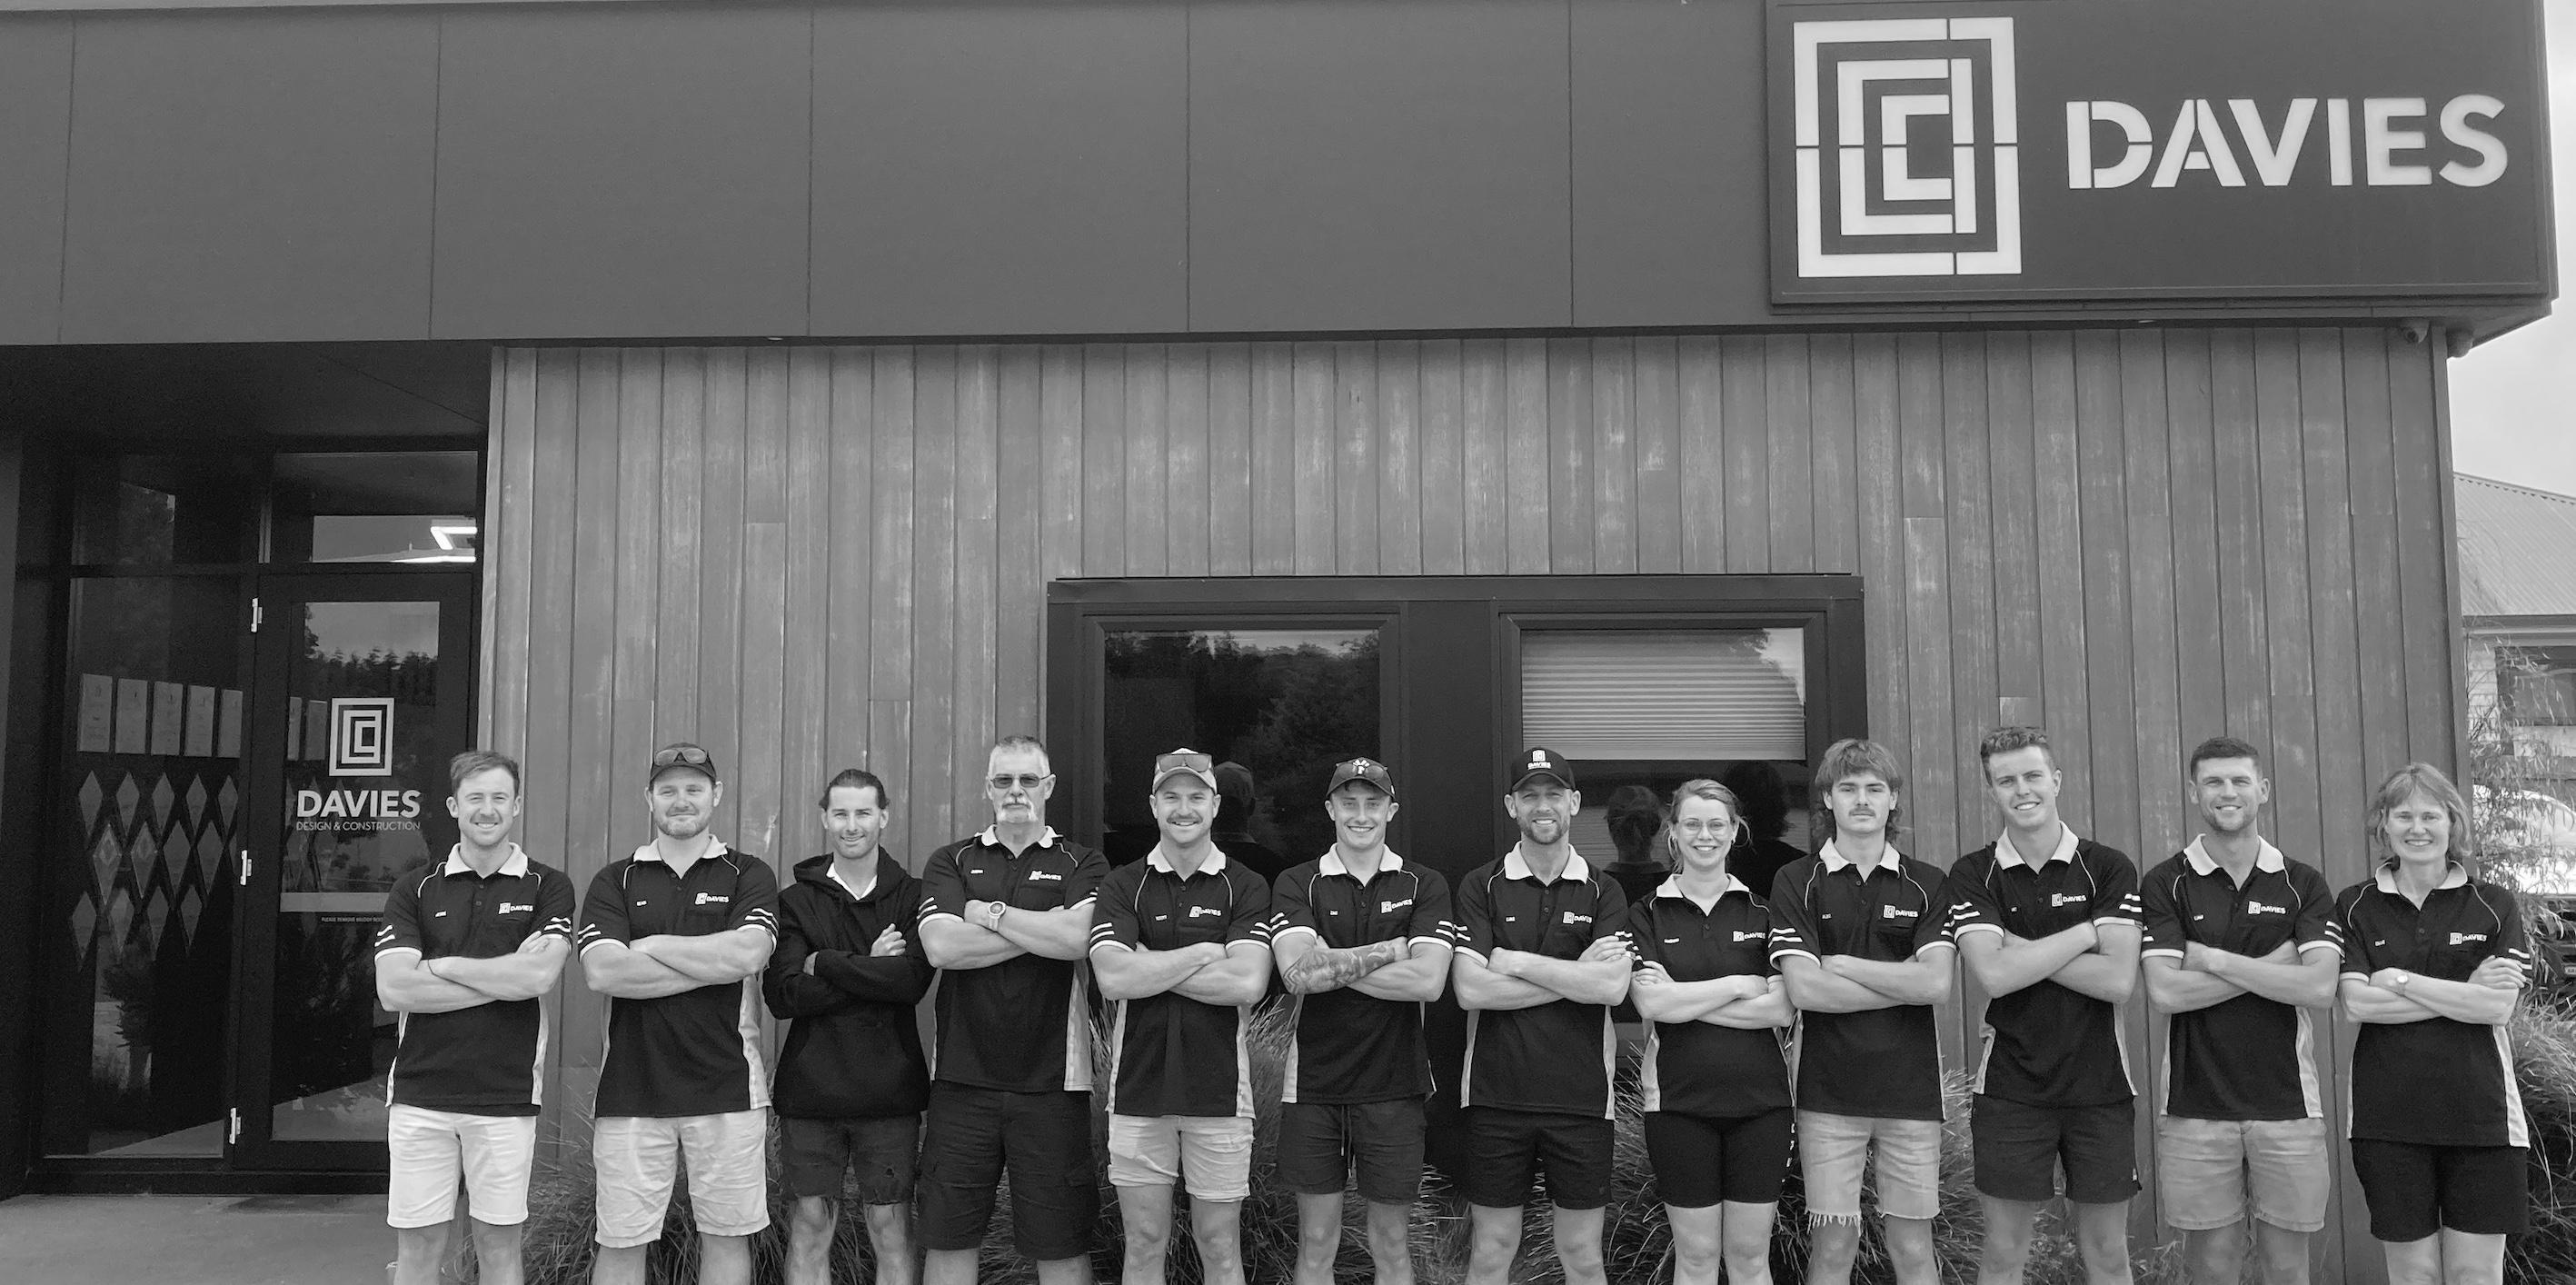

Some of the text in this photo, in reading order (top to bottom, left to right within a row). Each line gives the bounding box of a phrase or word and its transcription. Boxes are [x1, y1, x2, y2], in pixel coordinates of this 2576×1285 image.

[2066, 94, 2509, 189] DAVIES
[296, 789, 422, 818] DAVIES
[296, 821, 421, 831] DESIGN & CONSTRUCTION
[2063, 895, 2087, 903] DAVIES
[511, 904, 533, 912] DAVIES
[1391, 899, 1413, 910] DAVIES
[1199, 909, 1222, 917] DAVIES
[1895, 910, 1918, 918] DAVIES
[2261, 906, 2286, 914] DAVIES
[2462, 934, 2487, 942] DAVIES
